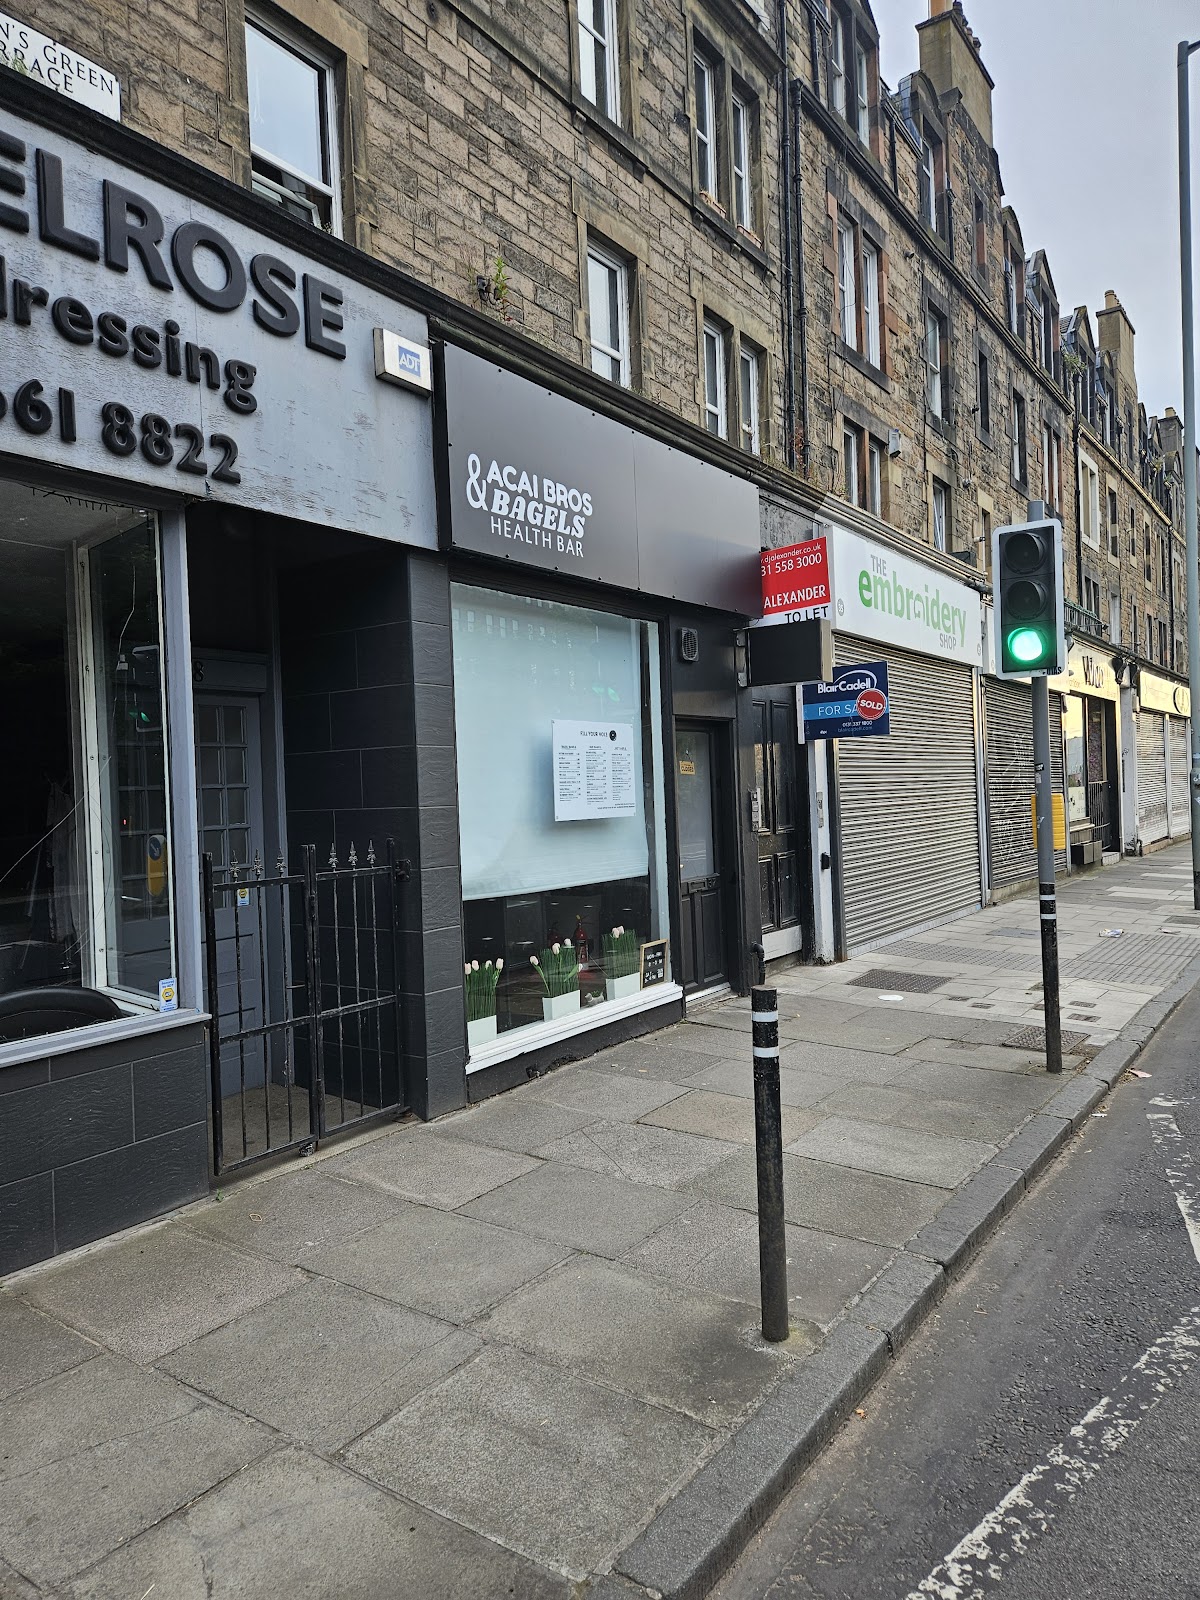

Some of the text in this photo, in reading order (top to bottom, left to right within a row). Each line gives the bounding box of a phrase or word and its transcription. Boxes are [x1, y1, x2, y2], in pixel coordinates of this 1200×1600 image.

[43, 45, 114, 97] GREEN
[0, 130, 347, 360] ELROSE
[399, 352, 421, 372] ADT
[0, 379, 241, 484] 61 8822
[466, 453, 586, 539] & BAGELS
[487, 460, 593, 517] ACAI BROS
[490, 516, 584, 558] HEALTH BAR
[775, 559, 795, 574] 558
[796, 552, 822, 569] 3000
[871, 554, 887, 577] THE
[764, 584, 827, 609] ALEXANDER
[785, 606, 829, 624] TO LET
[858, 570, 967, 648] embroidery
[940, 633, 957, 651] SHOP
[817, 677, 871, 694] BlairCadell
[818, 704, 858, 717] FOR SA
[859, 699, 883, 711] SOLD
